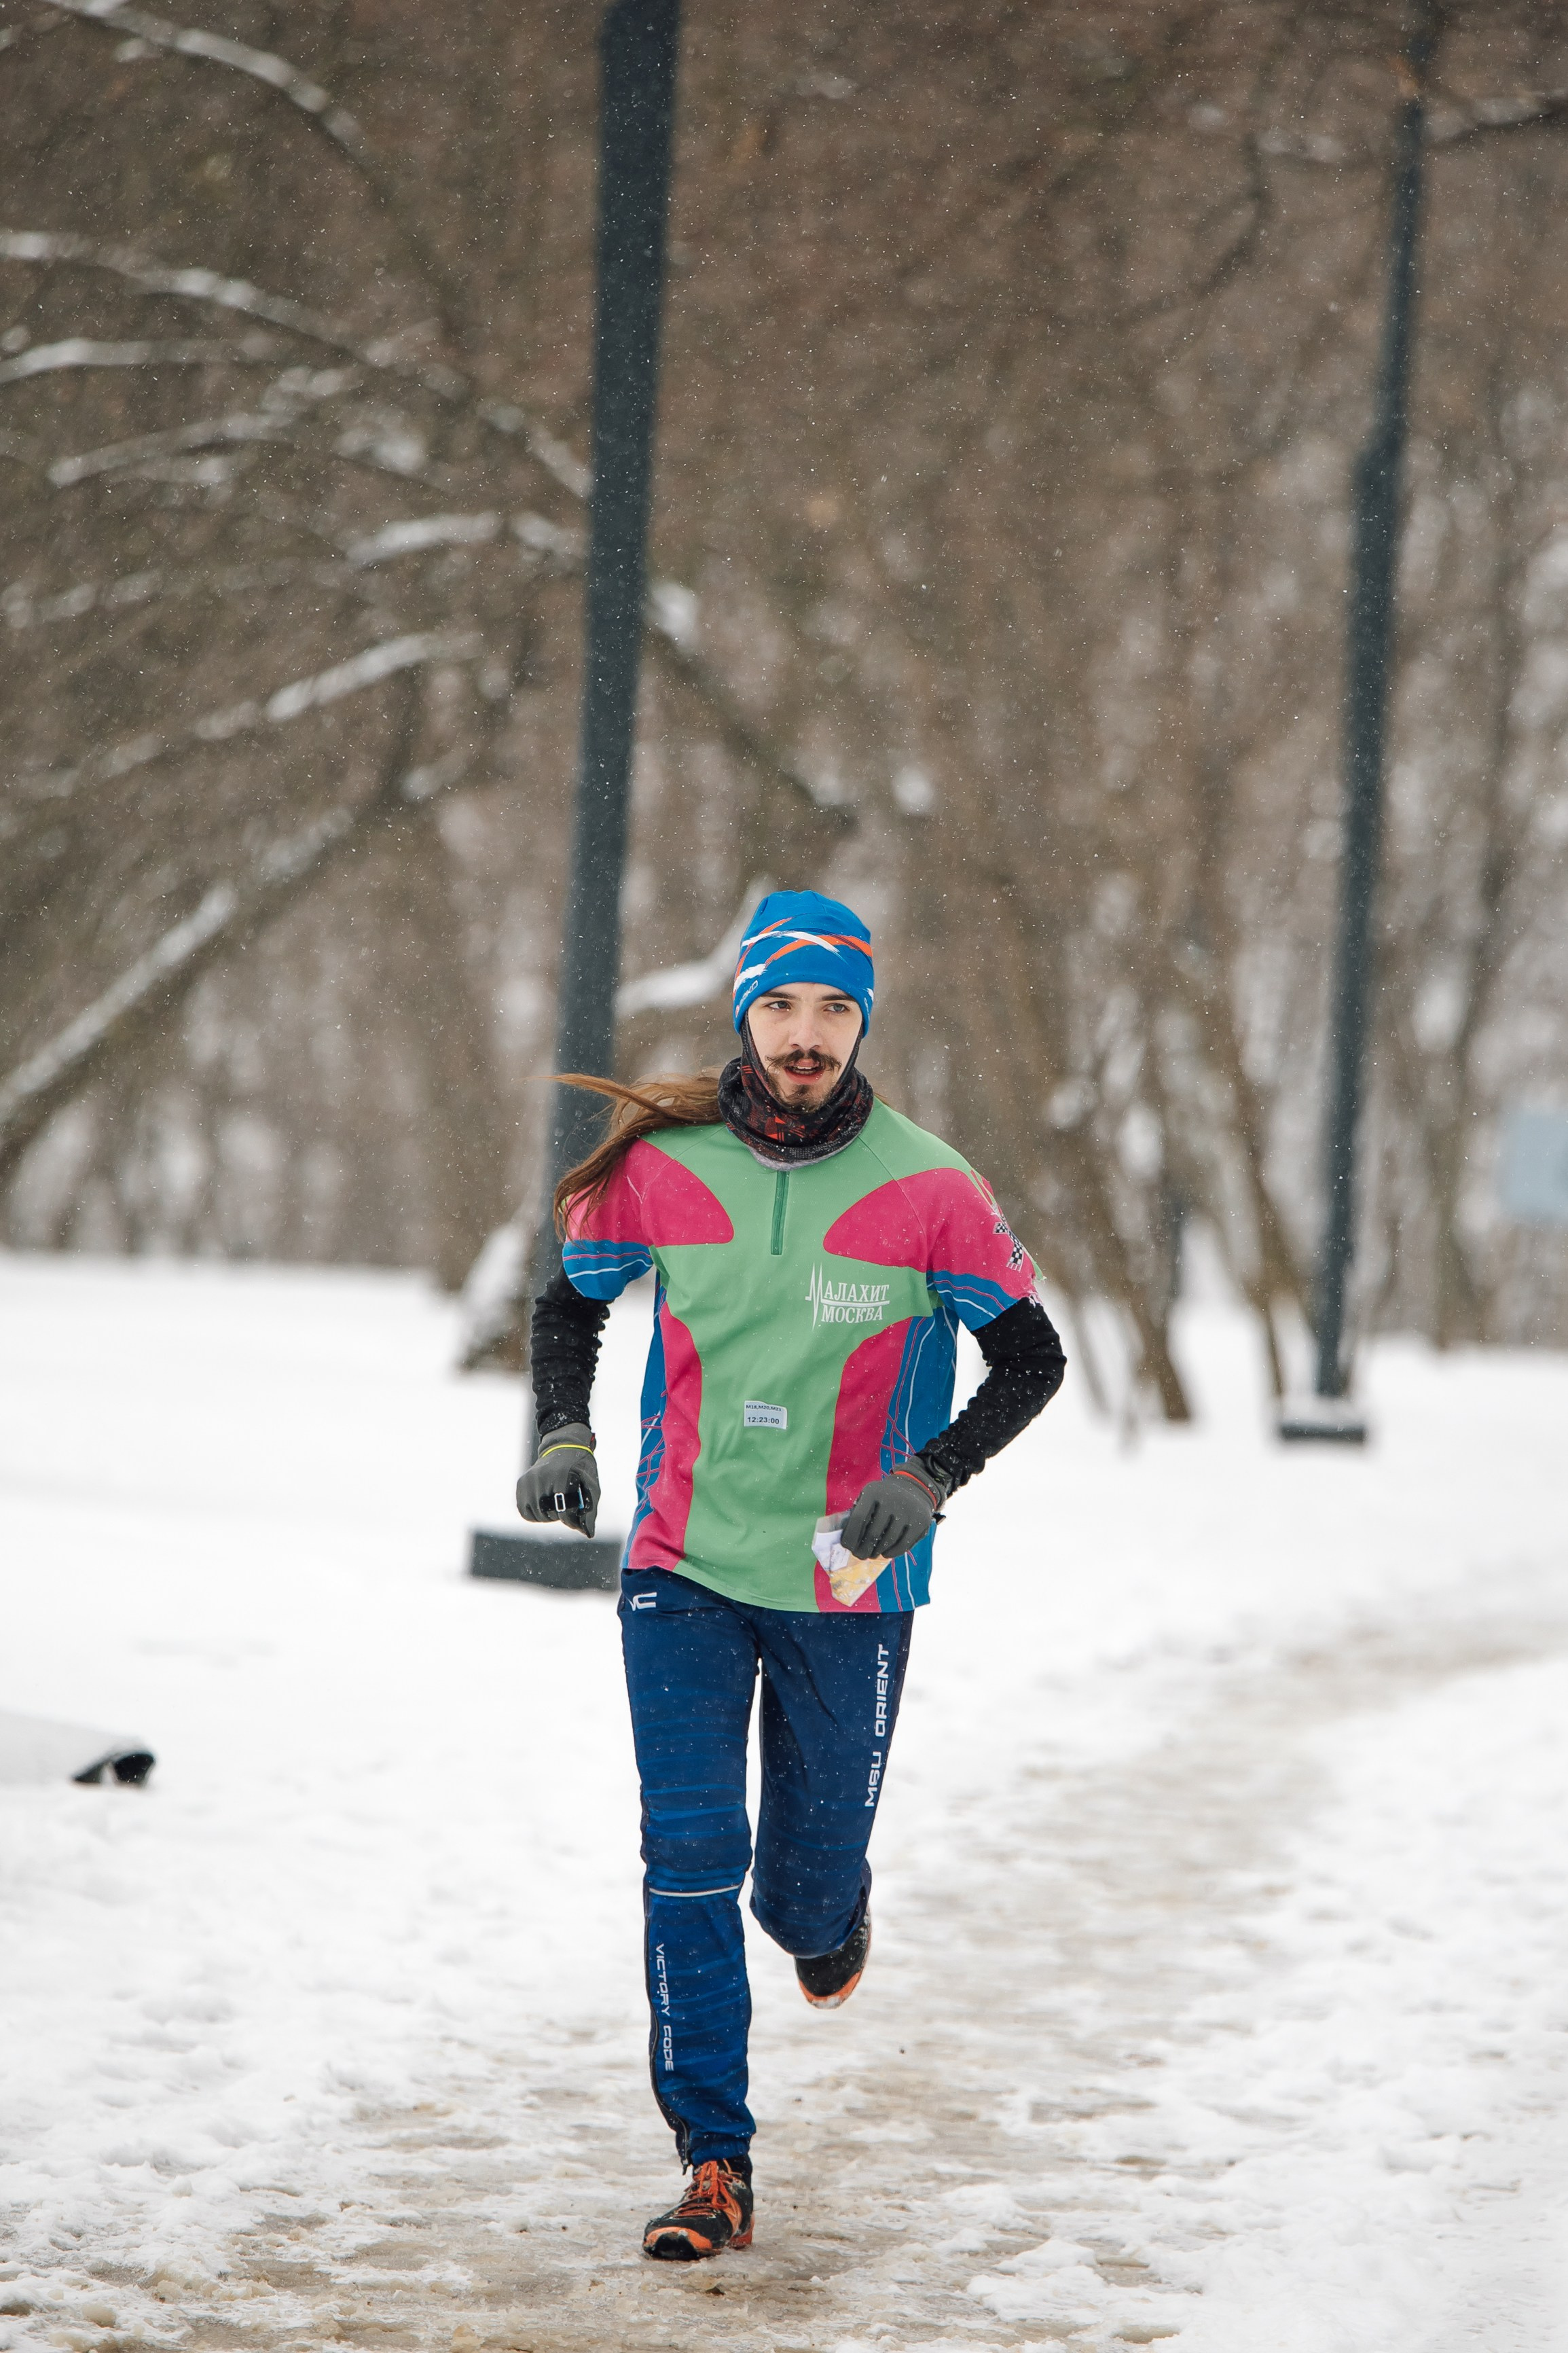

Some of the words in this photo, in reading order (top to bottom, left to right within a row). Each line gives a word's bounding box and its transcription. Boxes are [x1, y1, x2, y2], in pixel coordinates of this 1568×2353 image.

[805, 1262, 890, 1331] МАЛАХИТ
[821, 1304, 883, 1323] МОСКВА
[747, 1416, 780, 1424] 12:23:00
[864, 1751, 881, 1808] MSU
[875, 1643, 889, 1738] ORIENT
[655, 1943, 671, 2017] VICTORY
[663, 2025, 674, 2071] CODE
